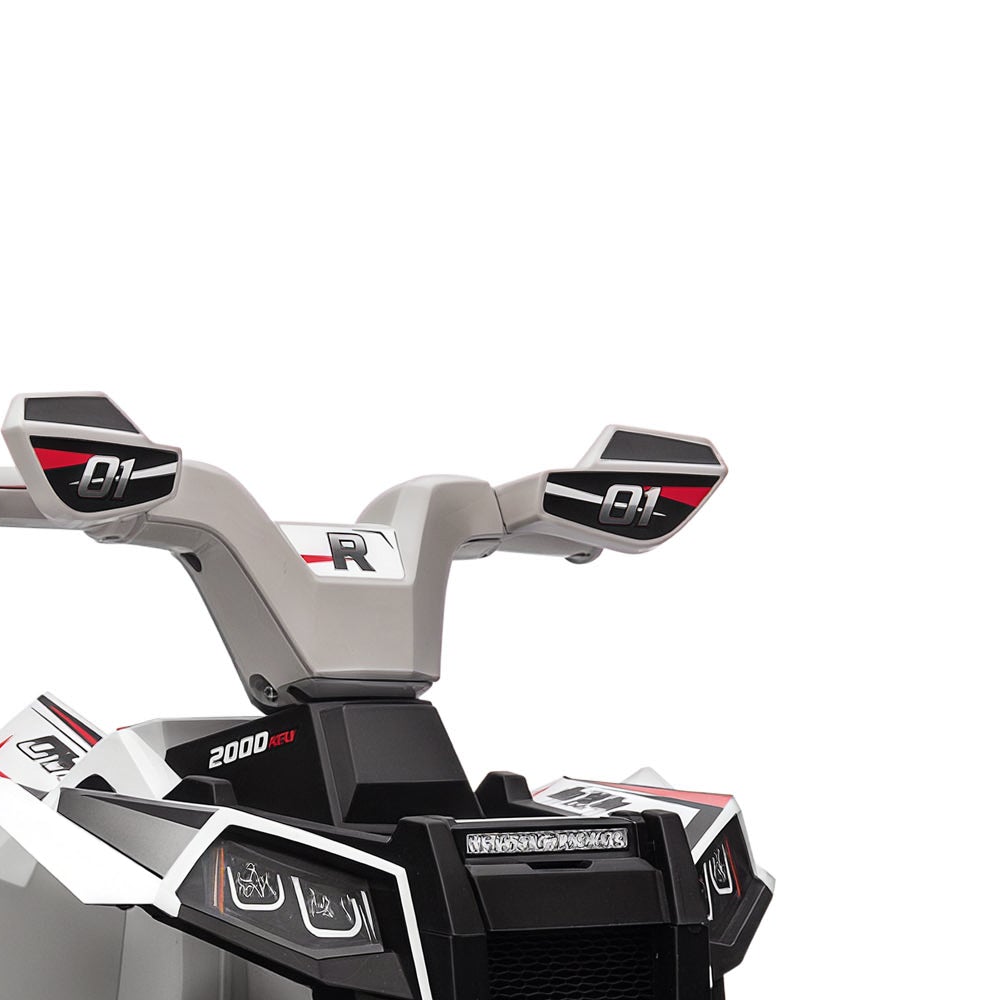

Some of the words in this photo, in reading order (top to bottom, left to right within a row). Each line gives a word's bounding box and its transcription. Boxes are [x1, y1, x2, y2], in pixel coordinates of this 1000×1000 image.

[77, 454, 136, 499] 01
[599, 484, 663, 527] 01
[326, 531, 376, 572] R
